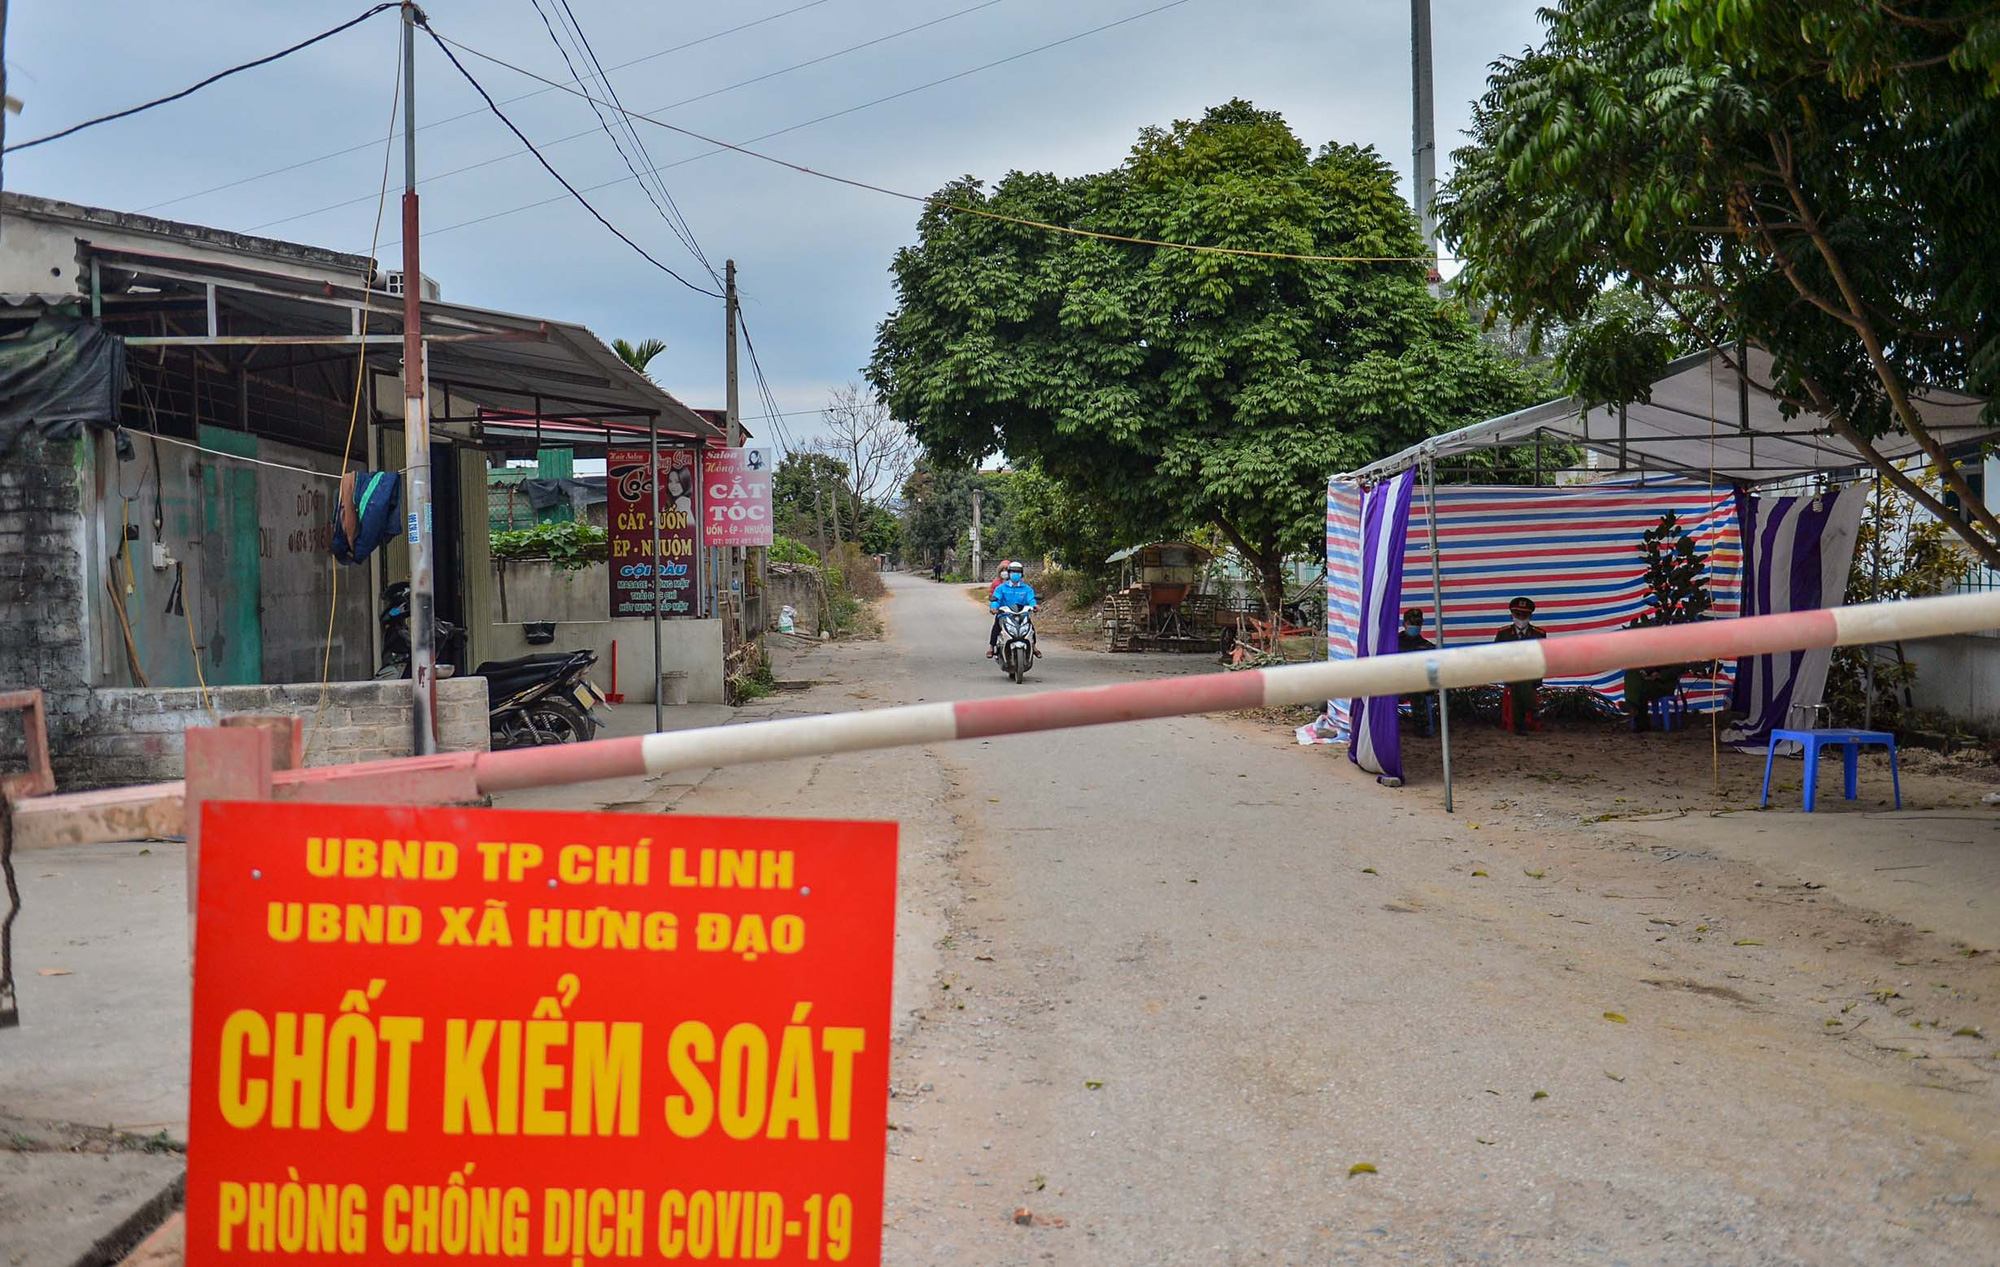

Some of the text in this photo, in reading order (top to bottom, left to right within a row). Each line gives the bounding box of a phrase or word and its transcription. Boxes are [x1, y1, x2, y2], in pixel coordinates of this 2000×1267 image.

[709, 475, 766, 499] CẮT
[617, 503, 687, 530] CẮT UỐN
[709, 501, 765, 521] TÓC
[706, 522, 723, 536] UỐN
[612, 534, 631, 557] ÉP
[620, 562, 652, 579] GỘI
[306, 837, 795, 890] UBND TP CHÍ LINH
[267, 899, 805, 961] UBND XÃ HƯNG ĐẠO
[218, 973, 866, 1141] CHỐT KIỂM SOÁT
[218, 1162, 853, 1267] PHÒNG CHỐNG DỊCH COVID-19
